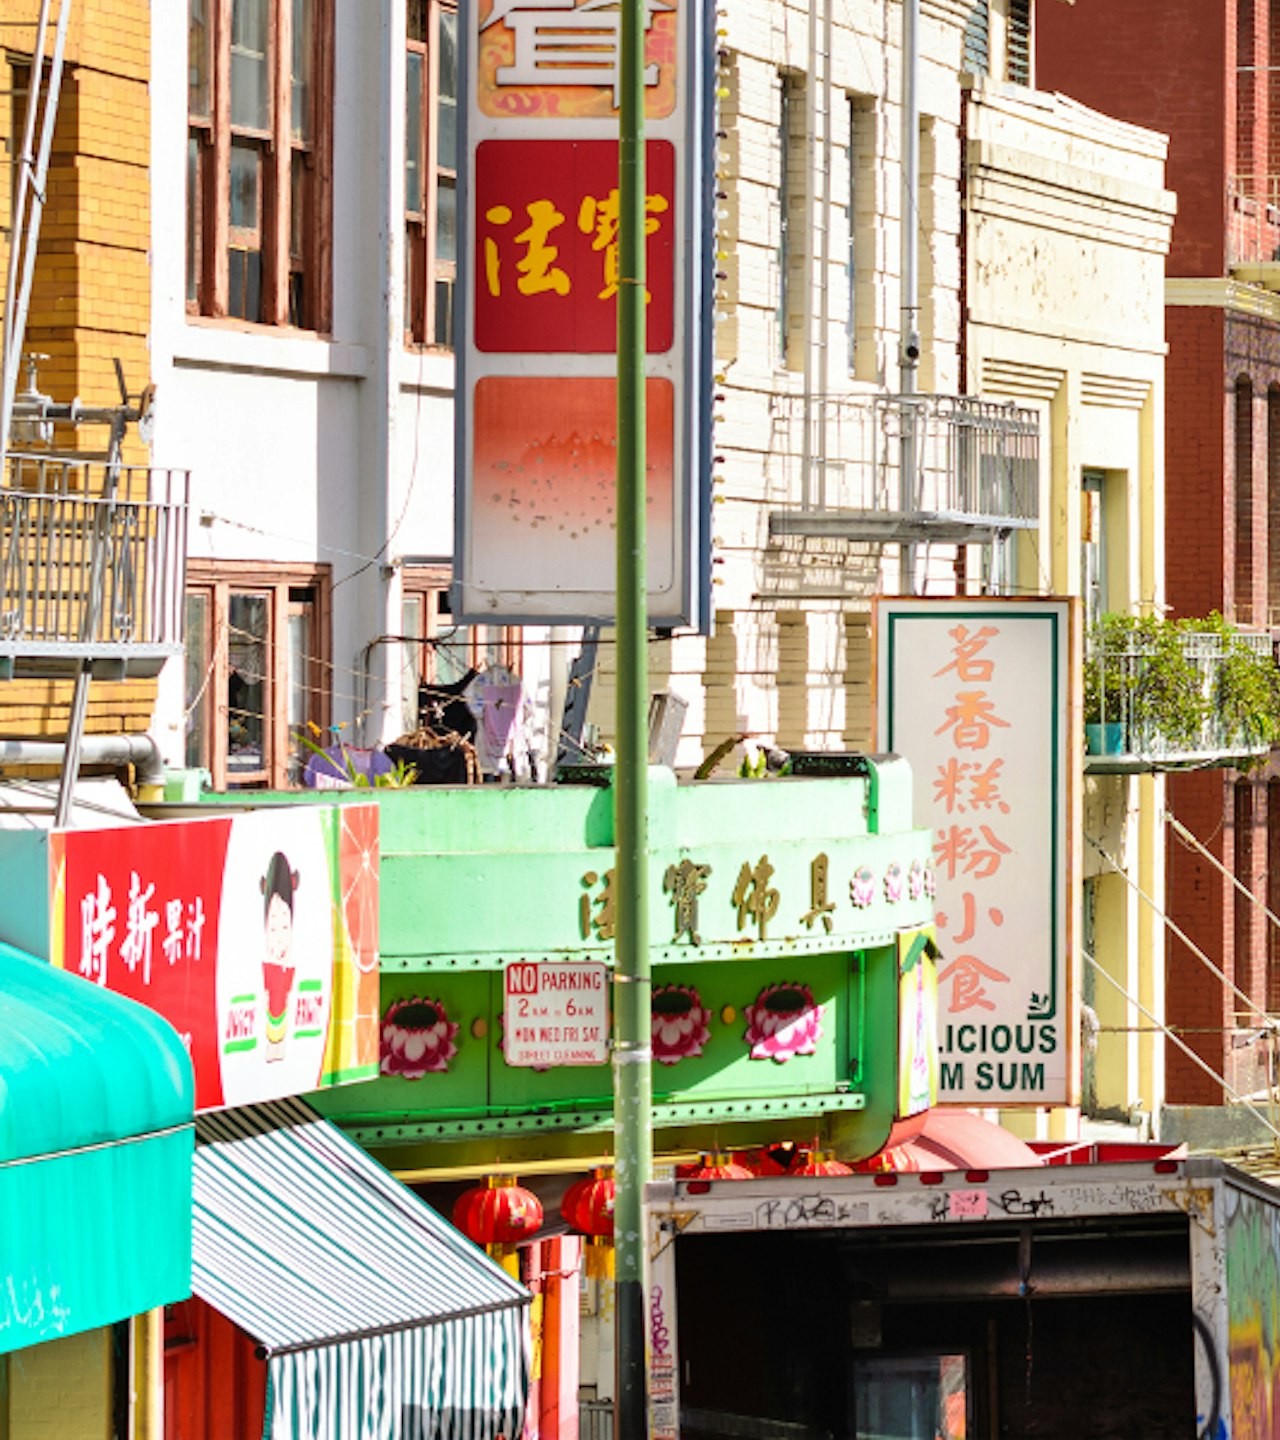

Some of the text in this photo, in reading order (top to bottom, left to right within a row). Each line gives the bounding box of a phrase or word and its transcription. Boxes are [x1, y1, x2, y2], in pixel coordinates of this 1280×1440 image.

[509, 965, 601, 992] NO PARKING
[938, 1024, 1057, 1054] ICIOUS
[940, 1062, 1045, 1091] M SUM
